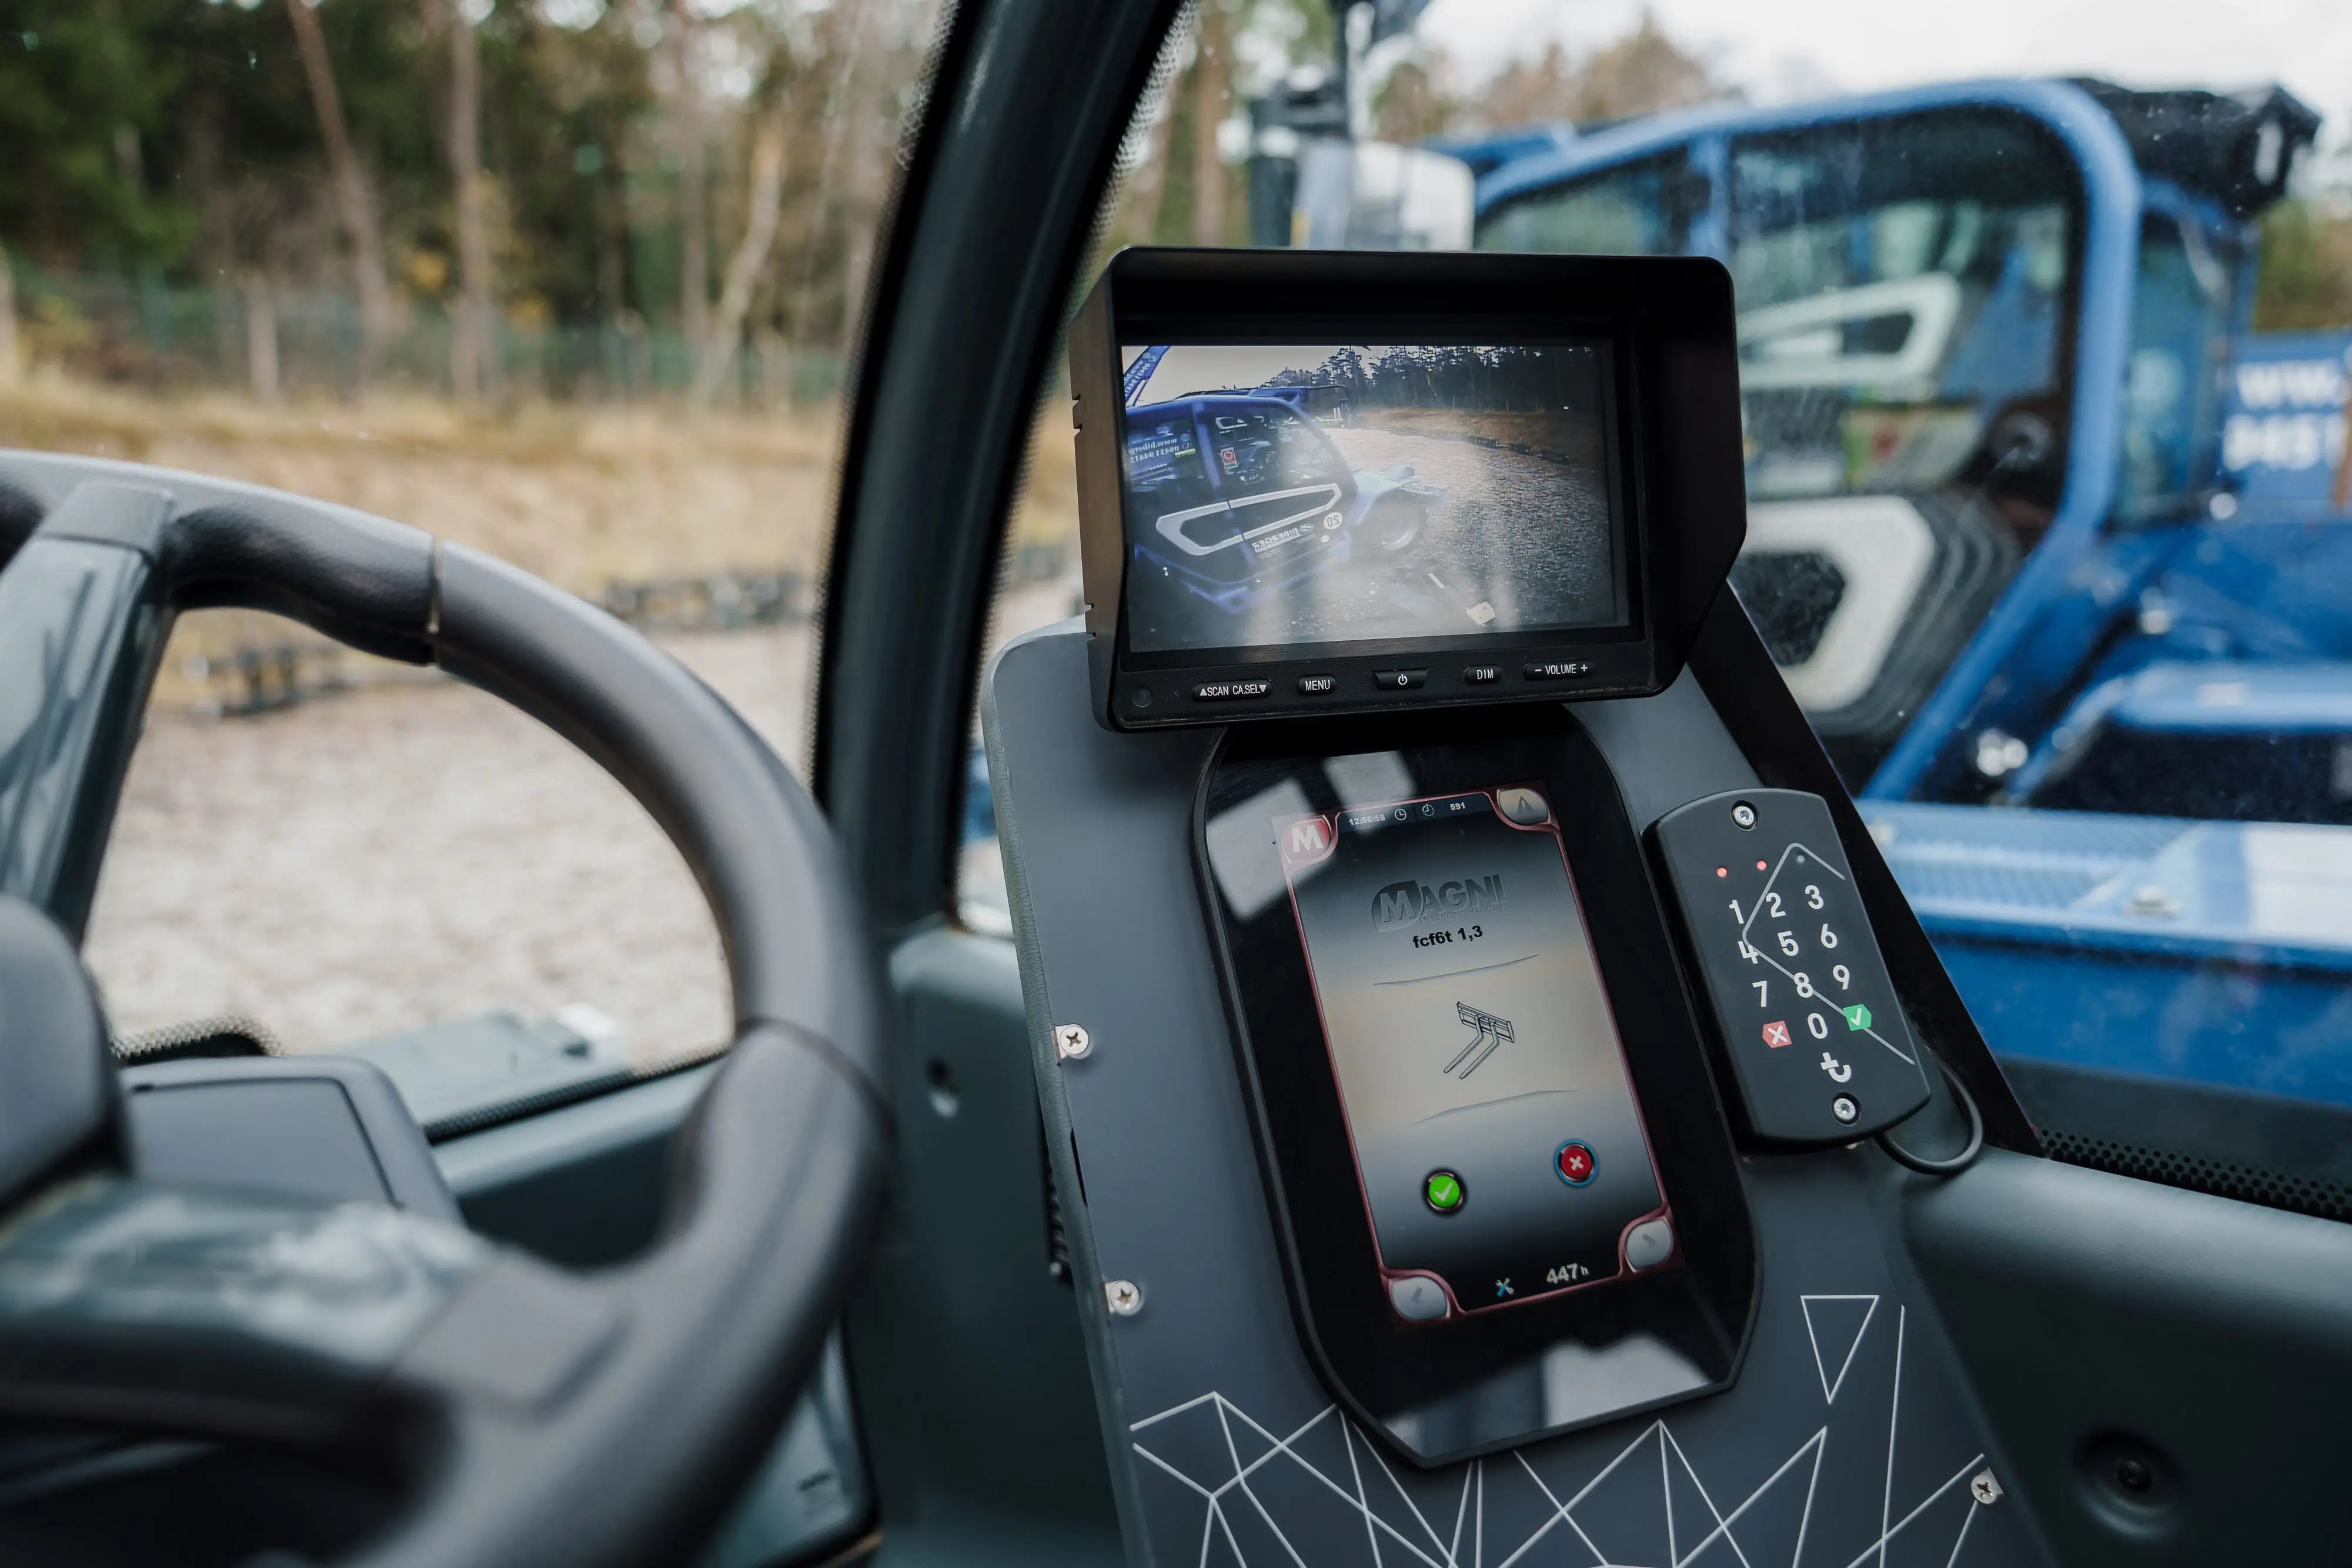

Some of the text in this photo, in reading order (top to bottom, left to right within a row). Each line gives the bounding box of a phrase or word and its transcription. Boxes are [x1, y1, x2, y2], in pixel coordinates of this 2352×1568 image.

[1476, 668, 1494, 680] DIM
[1545, 664, 1576, 675] VOLUME
[1207, 684, 1261, 697] SCAN CA.SEL
[1305, 679, 1331, 691] MENU
[1349, 802, 1466, 825] 12:56:58 591
[1291, 824, 1324, 852] M
[1379, 874, 1508, 922] MAGNI
[1729, 884, 1824, 924] 1 2 3
[1412, 925, 1484, 948] fcf6t 1,3
[1738, 923, 1838, 964] 4 5 6
[1752, 964, 1850, 1008] 7 8 9
[1807, 1012, 1828, 1039] 0
